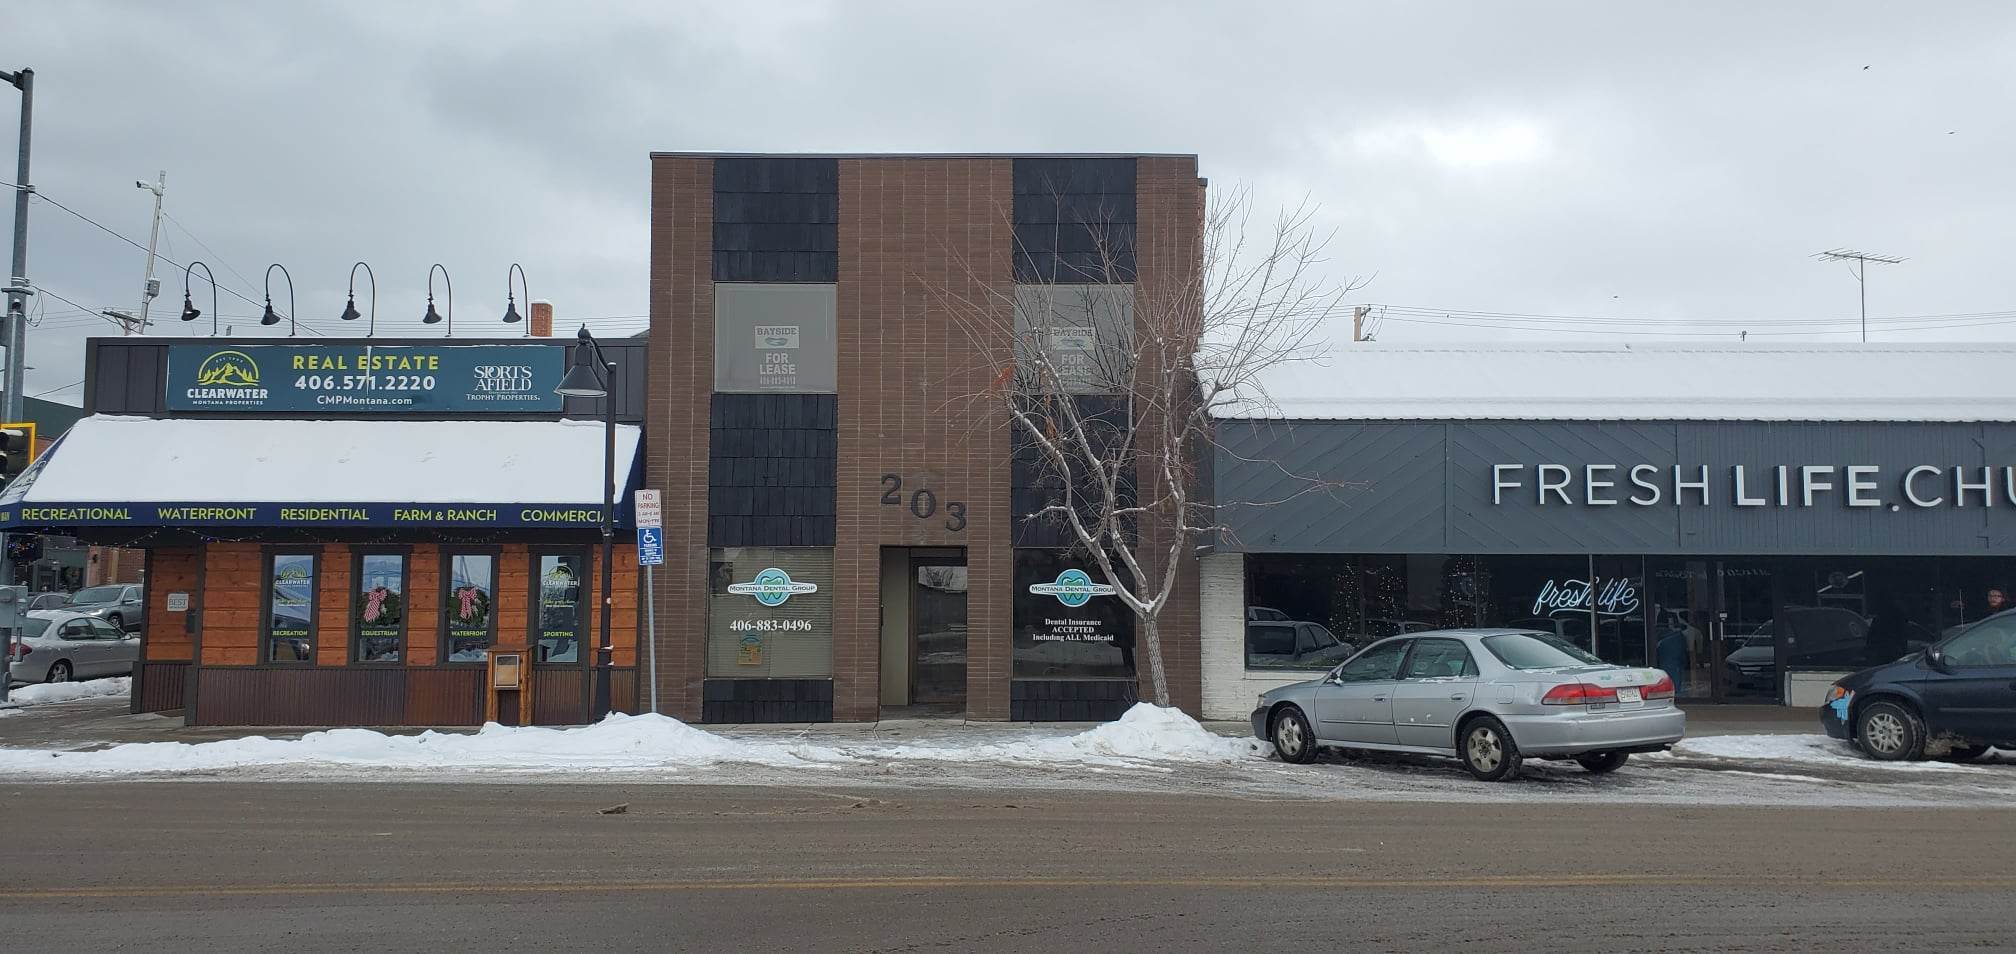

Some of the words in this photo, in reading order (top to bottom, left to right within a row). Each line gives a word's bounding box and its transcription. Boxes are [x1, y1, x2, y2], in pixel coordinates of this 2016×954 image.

[756, 327, 797, 336] BAYSIDE
[293, 355, 348, 370] REAL
[357, 355, 439, 370] ESTATE
[765, 353, 789, 364] FOR
[1061, 354, 1085, 365] FOR
[473, 365, 533, 379] SPORTS
[760, 364, 796, 375] LEASE
[294, 375, 436, 390] 406.571.2220
[474, 378, 532, 391] AFIELD
[186, 388, 269, 399] CLEARWATER
[466, 393, 494, 401] TROPHY
[316, 395, 413, 405] CMPMontana.com
[1491, 463, 1710, 506] FRESH
[642, 493, 654, 501] NO
[21, 508, 132, 520] RECREATIONAL
[158, 507, 257, 520] WATERFRONT
[280, 508, 370, 521] RESIDENTIAL
[394, 509, 432, 521] FARM
[435, 510, 445, 521] &
[446, 509, 497, 522] RANCH
[520, 509, 619, 523] COMMERCIL
[1597, 577, 1639, 615] life
[729, 619, 812, 632] 406-883-0496
[1045, 618, 1068, 626] Dental
[1068, 618, 1102, 626] Insurance
[1033, 633, 1065, 642] Including
